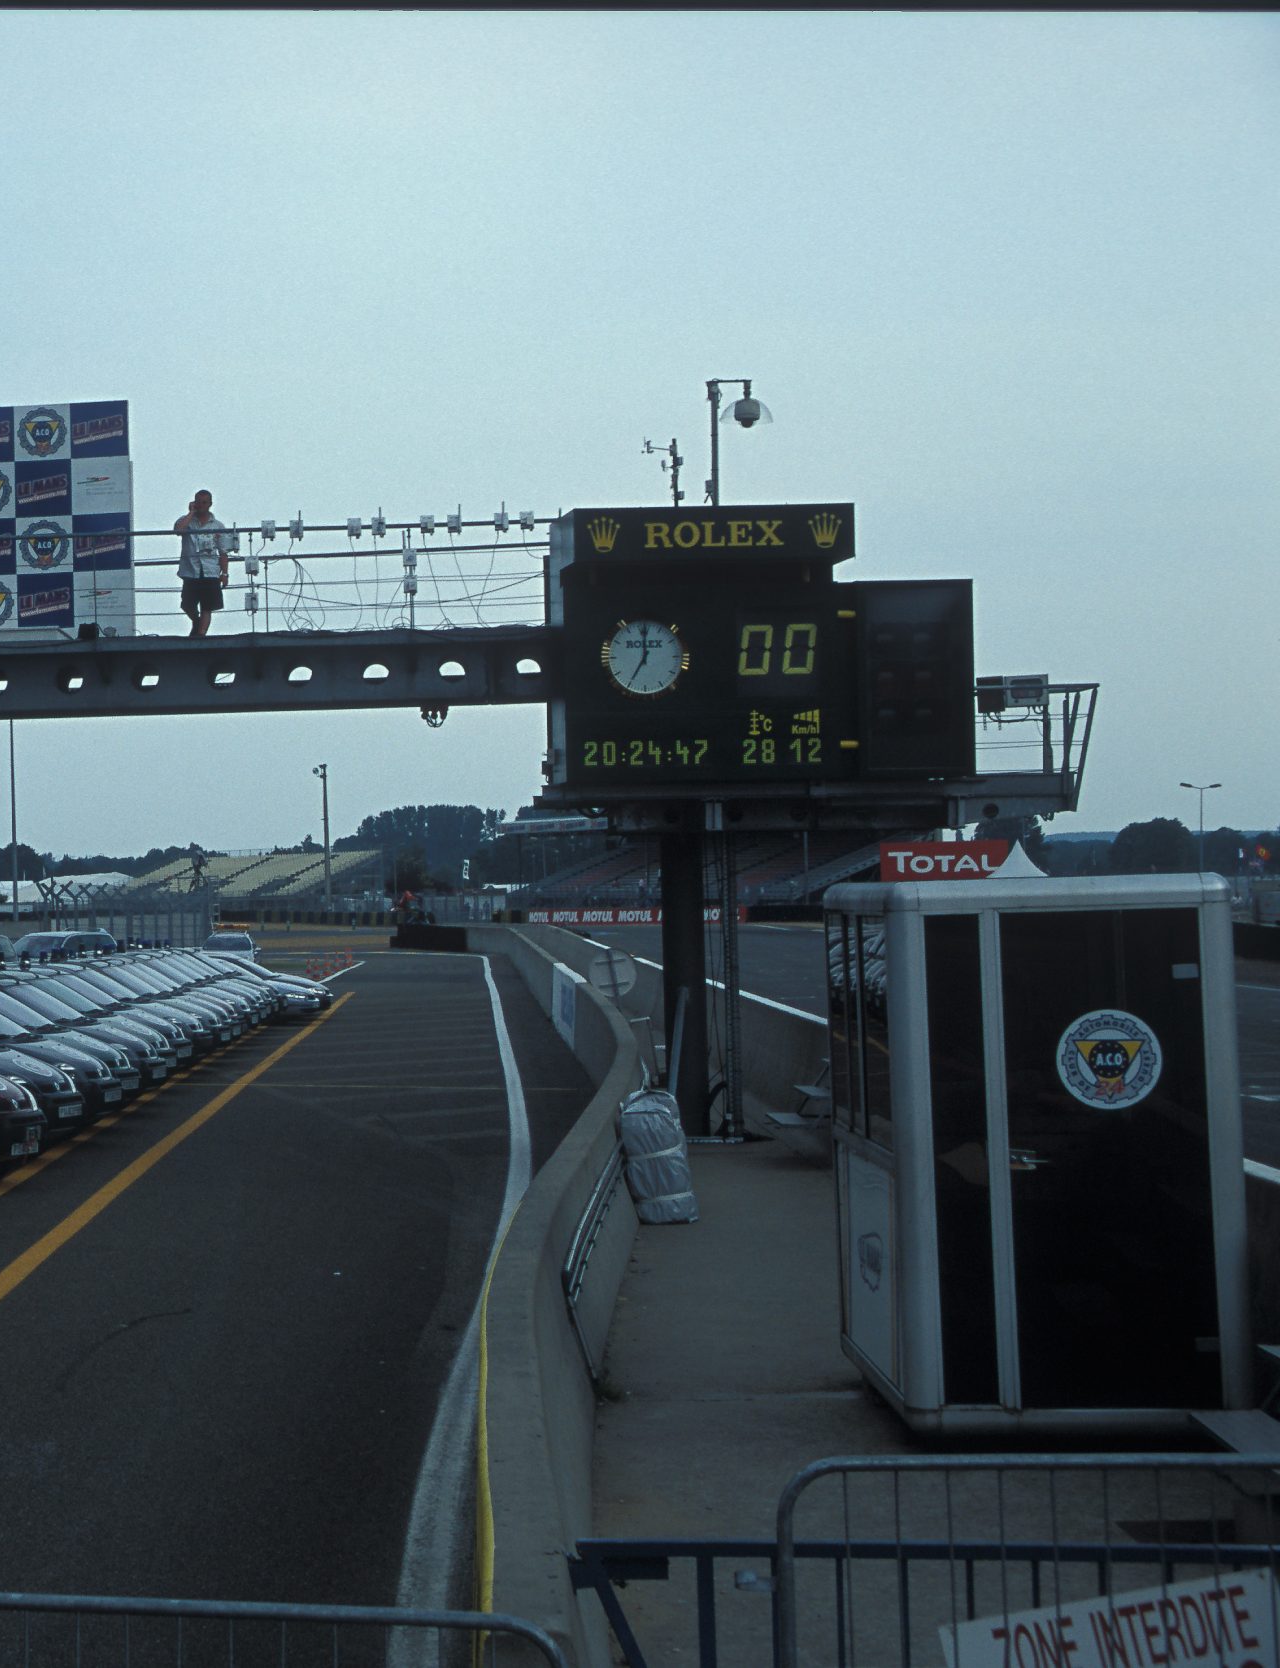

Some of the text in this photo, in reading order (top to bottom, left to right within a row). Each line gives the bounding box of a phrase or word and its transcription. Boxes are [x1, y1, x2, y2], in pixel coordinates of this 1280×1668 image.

[72, 415, 123, 439] LE MANS
[17, 481, 31, 497] LE
[31, 474, 67, 493] MANS
[74, 536, 87, 552] LE
[644, 521, 784, 548] ROLEX
[19, 594, 32, 610] LE
[33, 588, 70, 607] MANS
[626, 640, 662, 648] ROLEX
[738, 624, 817, 676] 00
[584, 738, 822, 766] 20:24:47 28 12
[888, 851, 1001, 874] TOTAL
[529, 911, 548, 923] MOTUL
[553, 911, 578, 923] MOTUL
[582, 910, 613, 922] MOTUL
[618, 910, 652, 922] MOTUL
[1079, 1020, 1139, 1037] AUTOMOBILE
[1068, 1050, 1078, 1076] CLUB
[1078, 1080, 1091, 1091] DE
[1095, 1081, 1125, 1096] 24
[991, 1586, 1259, 1668] ZONE INTERDITE
